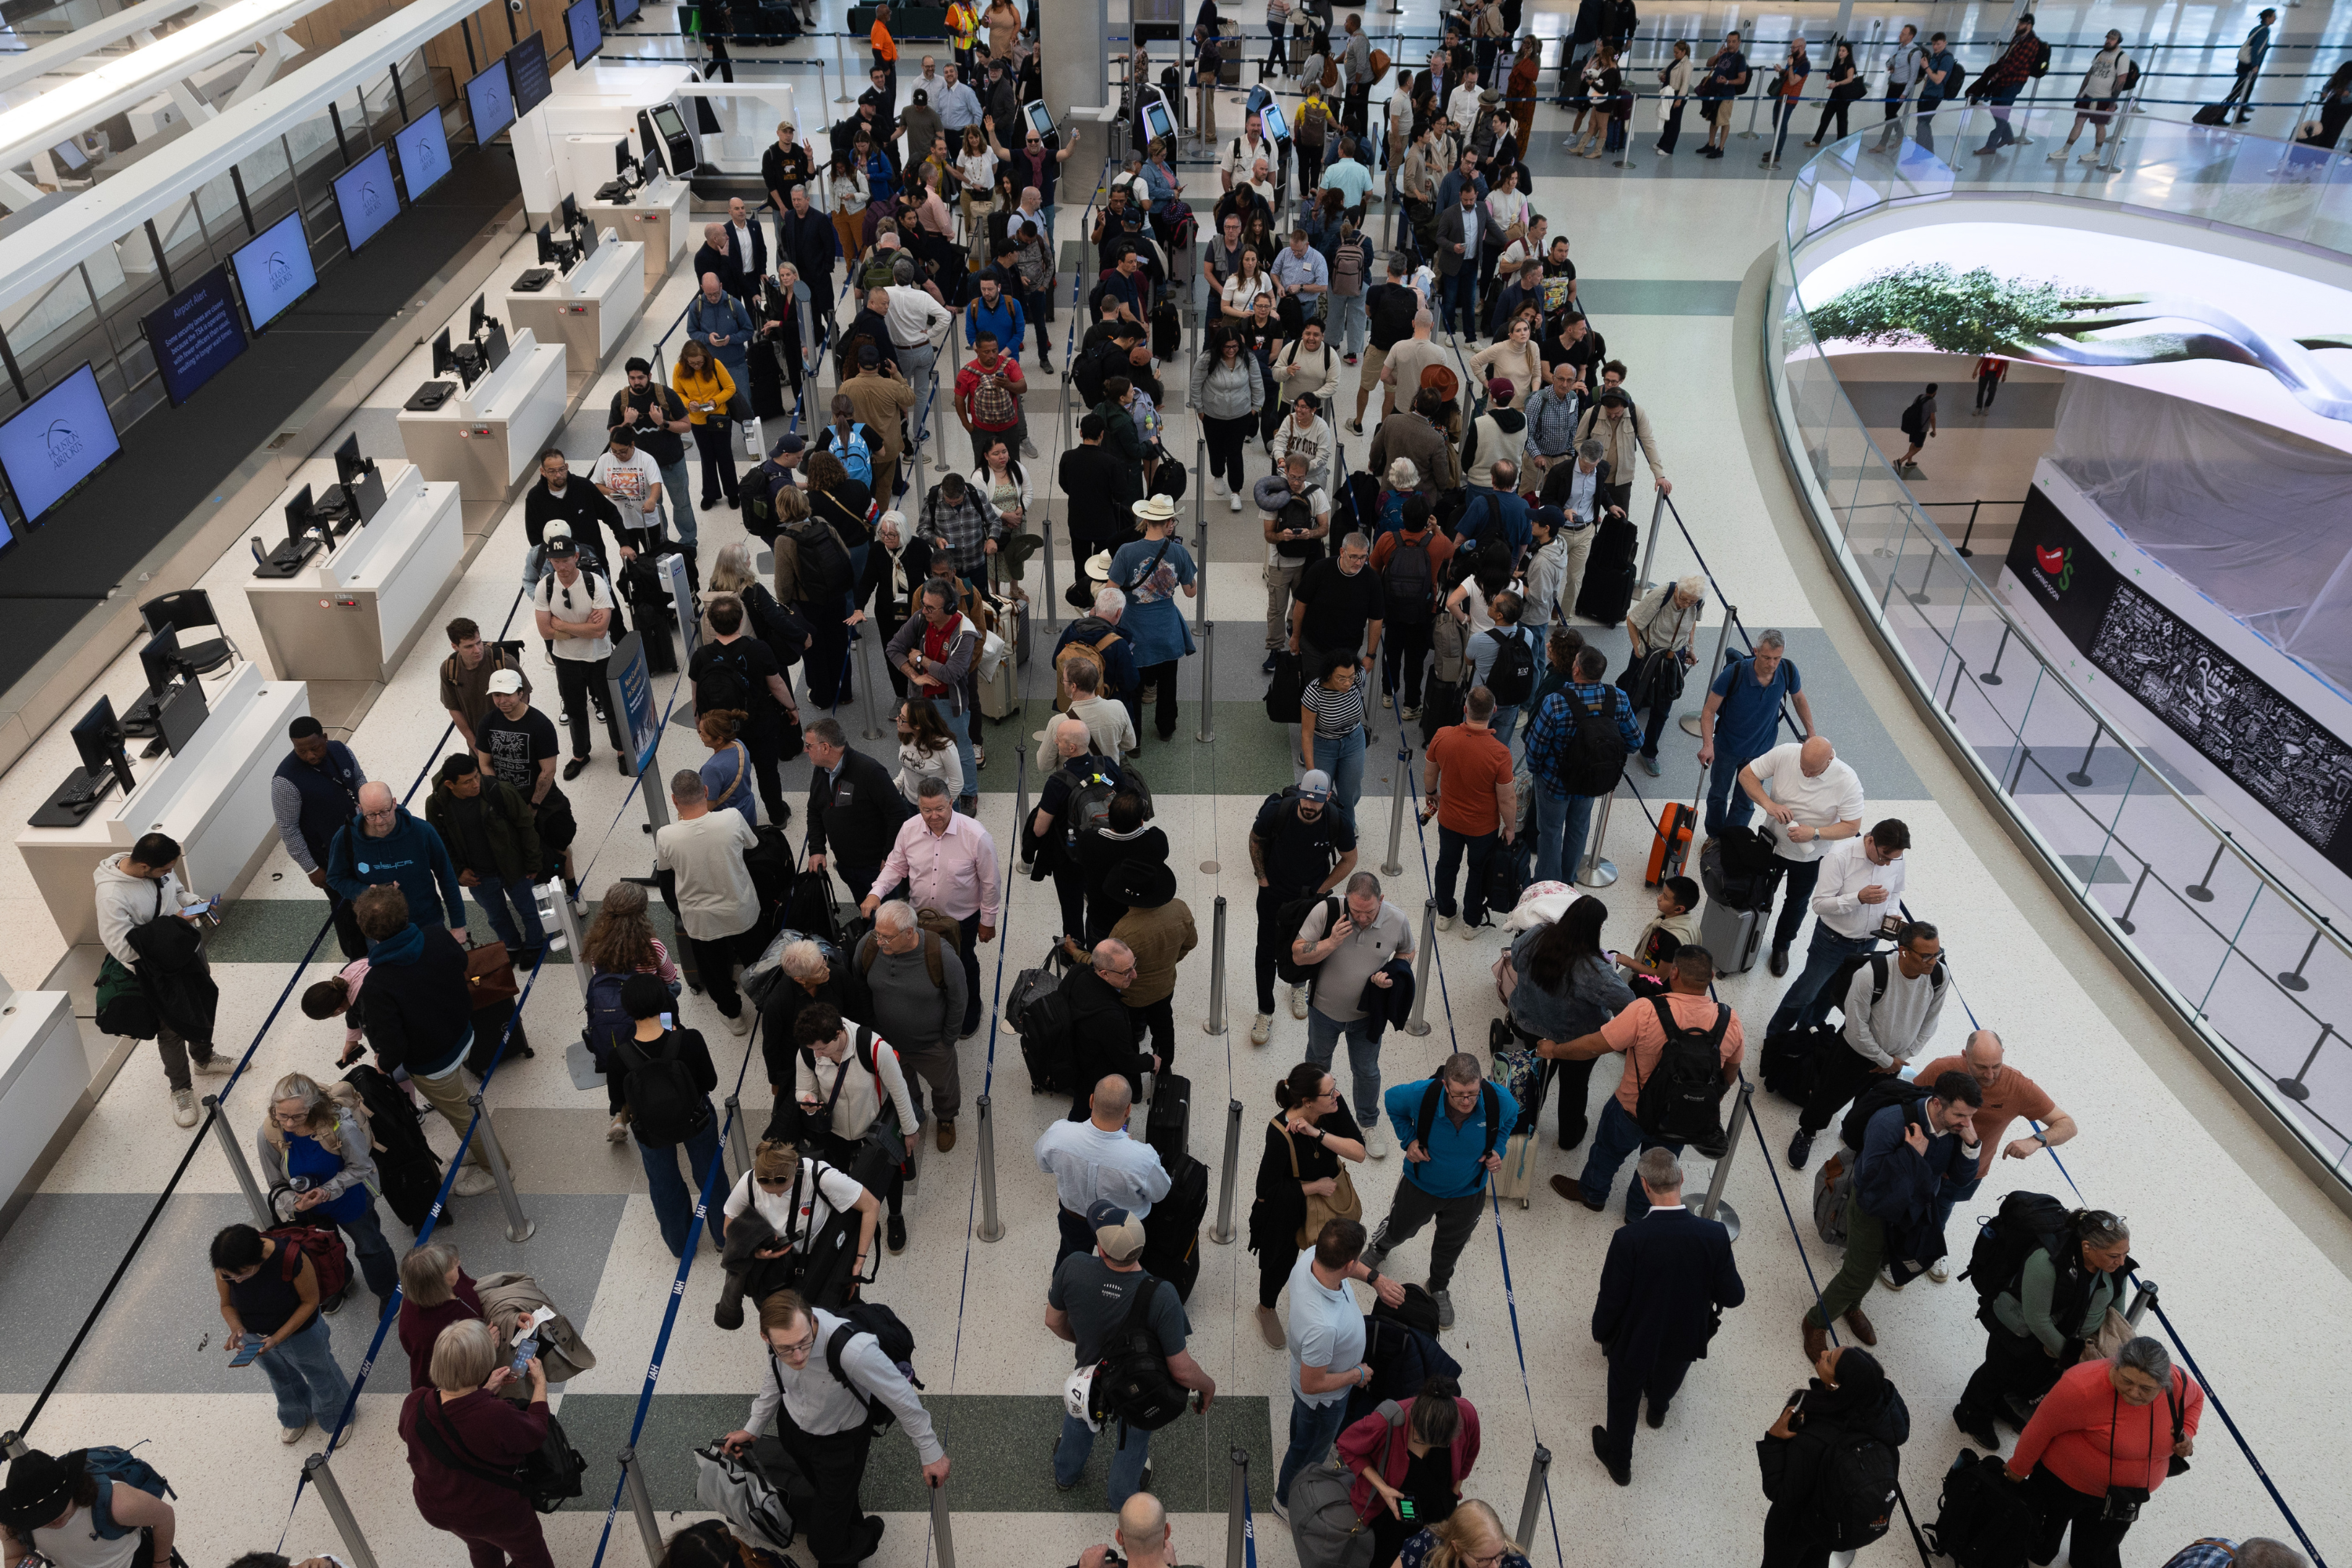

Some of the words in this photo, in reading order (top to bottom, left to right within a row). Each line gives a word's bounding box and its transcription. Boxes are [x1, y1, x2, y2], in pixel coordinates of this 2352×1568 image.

[269, 263, 290, 283] HOUSTON
[273, 271, 293, 292] AIRPORTS
[173, 299, 194, 319] Airport
[193, 289, 207, 305] Alert
[165, 334, 178, 347] Some
[177, 322, 194, 339] security
[193, 314, 205, 326] lanes
[211, 299, 224, 313] closed
[171, 339, 189, 355] because
[195, 326, 205, 336] TSA
[207, 310, 227, 328] operating
[173, 354, 183, 365] with
[183, 347, 195, 358] fewer
[194, 335, 210, 350] officers
[209, 327, 219, 337] than
[177, 358, 196, 375] resulting
[199, 344, 213, 358] longer
[212, 336, 222, 347] wait
[48, 430, 79, 461] HOUSTON
[53, 441, 83, 470] AIRPORTS
[1301, 437, 1318, 456] YORK
[2032, 567, 2049, 588] COMING
[2047, 584, 2060, 601] SOON
[2114, 626, 2127, 639] SPICY
[2209, 654, 2223, 665] SINCE
[2212, 720, 2230, 736] QUALITY
[2309, 745, 2323, 755] BACON
[430, 1202, 442, 1218] IAH
[695, 1204, 707, 1219] IAH
[673, 1279, 685, 1294] IAH
[361, 1359, 372, 1377] IAH
[648, 1363, 659, 1381] IAH
[607, 1504, 616, 1525] IAH
[2299, 1531, 2314, 1553] UNITED
